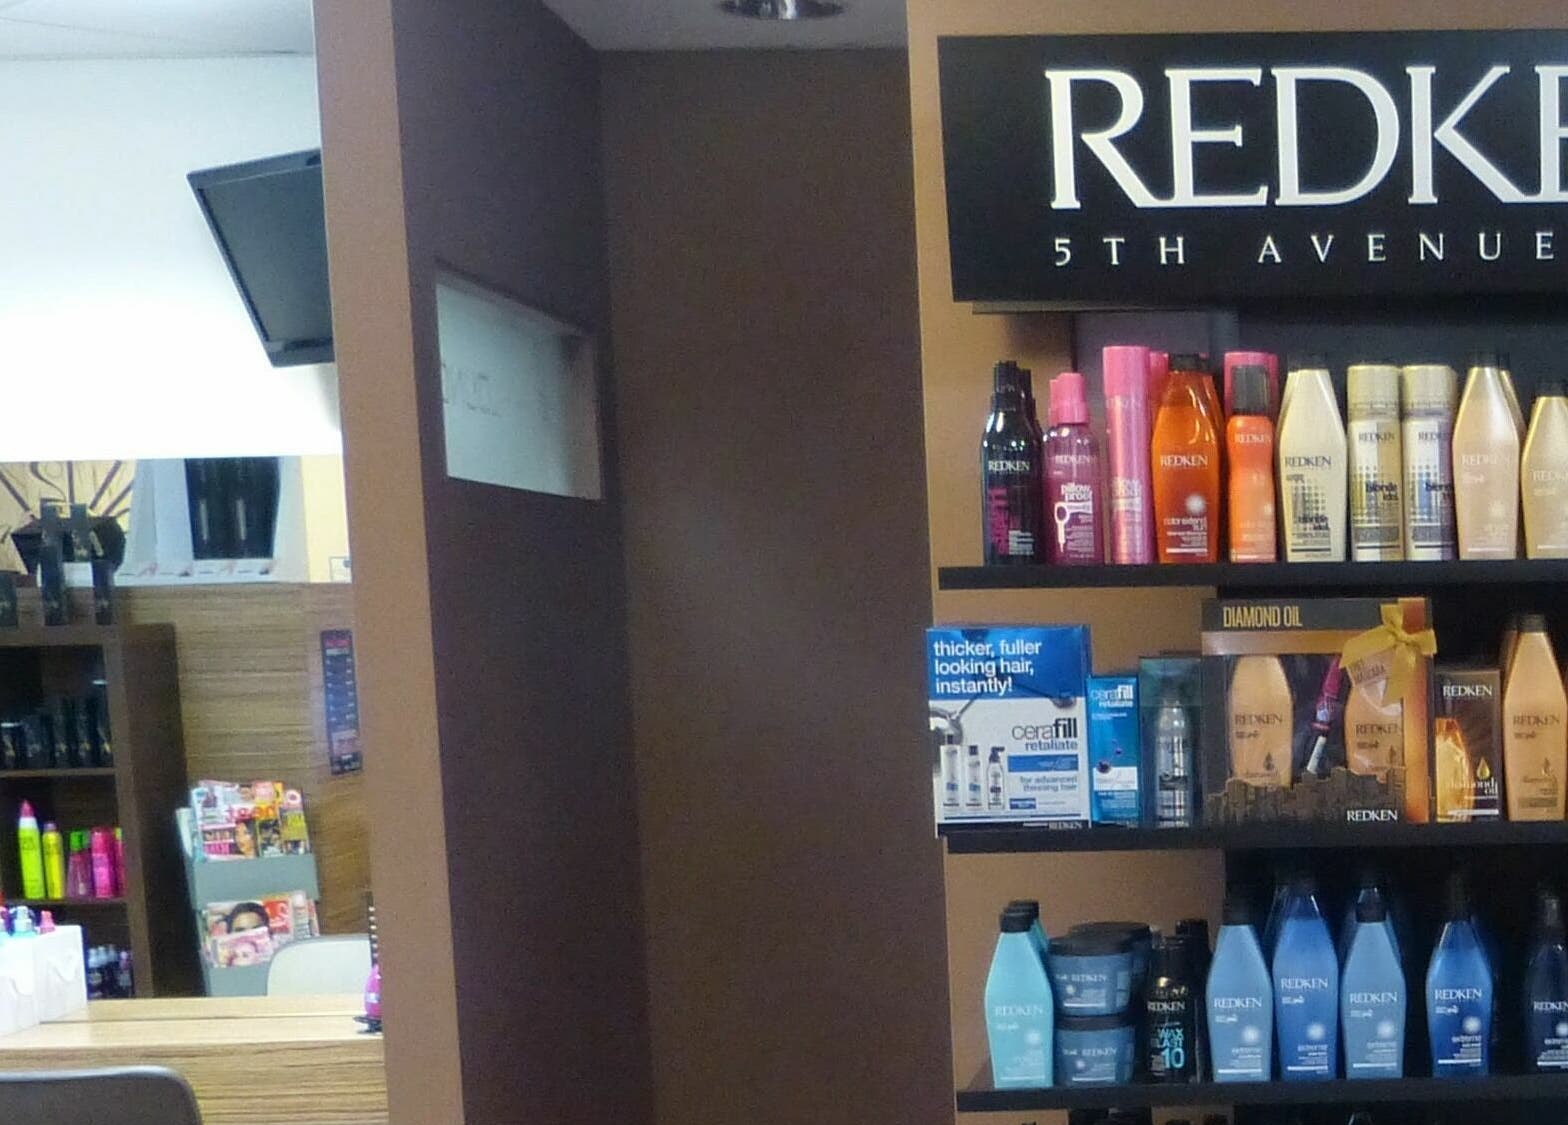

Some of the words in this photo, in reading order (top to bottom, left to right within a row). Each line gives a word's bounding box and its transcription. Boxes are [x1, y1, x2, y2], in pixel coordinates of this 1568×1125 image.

[1053, 235, 1187, 266] 5TH
[1258, 231, 1554, 264] AVENUE
[988, 460, 1030, 471] REDKEN
[1160, 455, 1208, 467] REDKEN
[1285, 456, 1332, 467] REDKEN
[1223, 606, 1281, 628] DIAMOND
[1282, 606, 1302, 627] OIL
[934, 640, 995, 660] thicker,
[1000, 639, 1042, 656] fuller
[934, 658, 996, 677] looking
[999, 657, 1034, 676] hair,
[935, 676, 1013, 695] instantly!
[1442, 684, 1493, 697] REDKEN
[1090, 685, 1134, 701] cerafill
[1234, 713, 1283, 726] REDKEN
[1513, 715, 1560, 727] REDKEN
[1011, 718, 1078, 741] cerafill
[1024, 739, 1078, 751] retaliate
[1346, 810, 1398, 821] REDKEN
[1281, 978, 1329, 990] REDKEN
[1350, 992, 1398, 1004] REDKEN
[1435, 988, 1482, 1001] REDKEN
[1148, 1000, 1186, 1012] REDKEN
[1213, 997, 1263, 1009] REDKEN
[1157, 1028, 1184, 1041] WAX
[1161, 1047, 1185, 1069] 10
